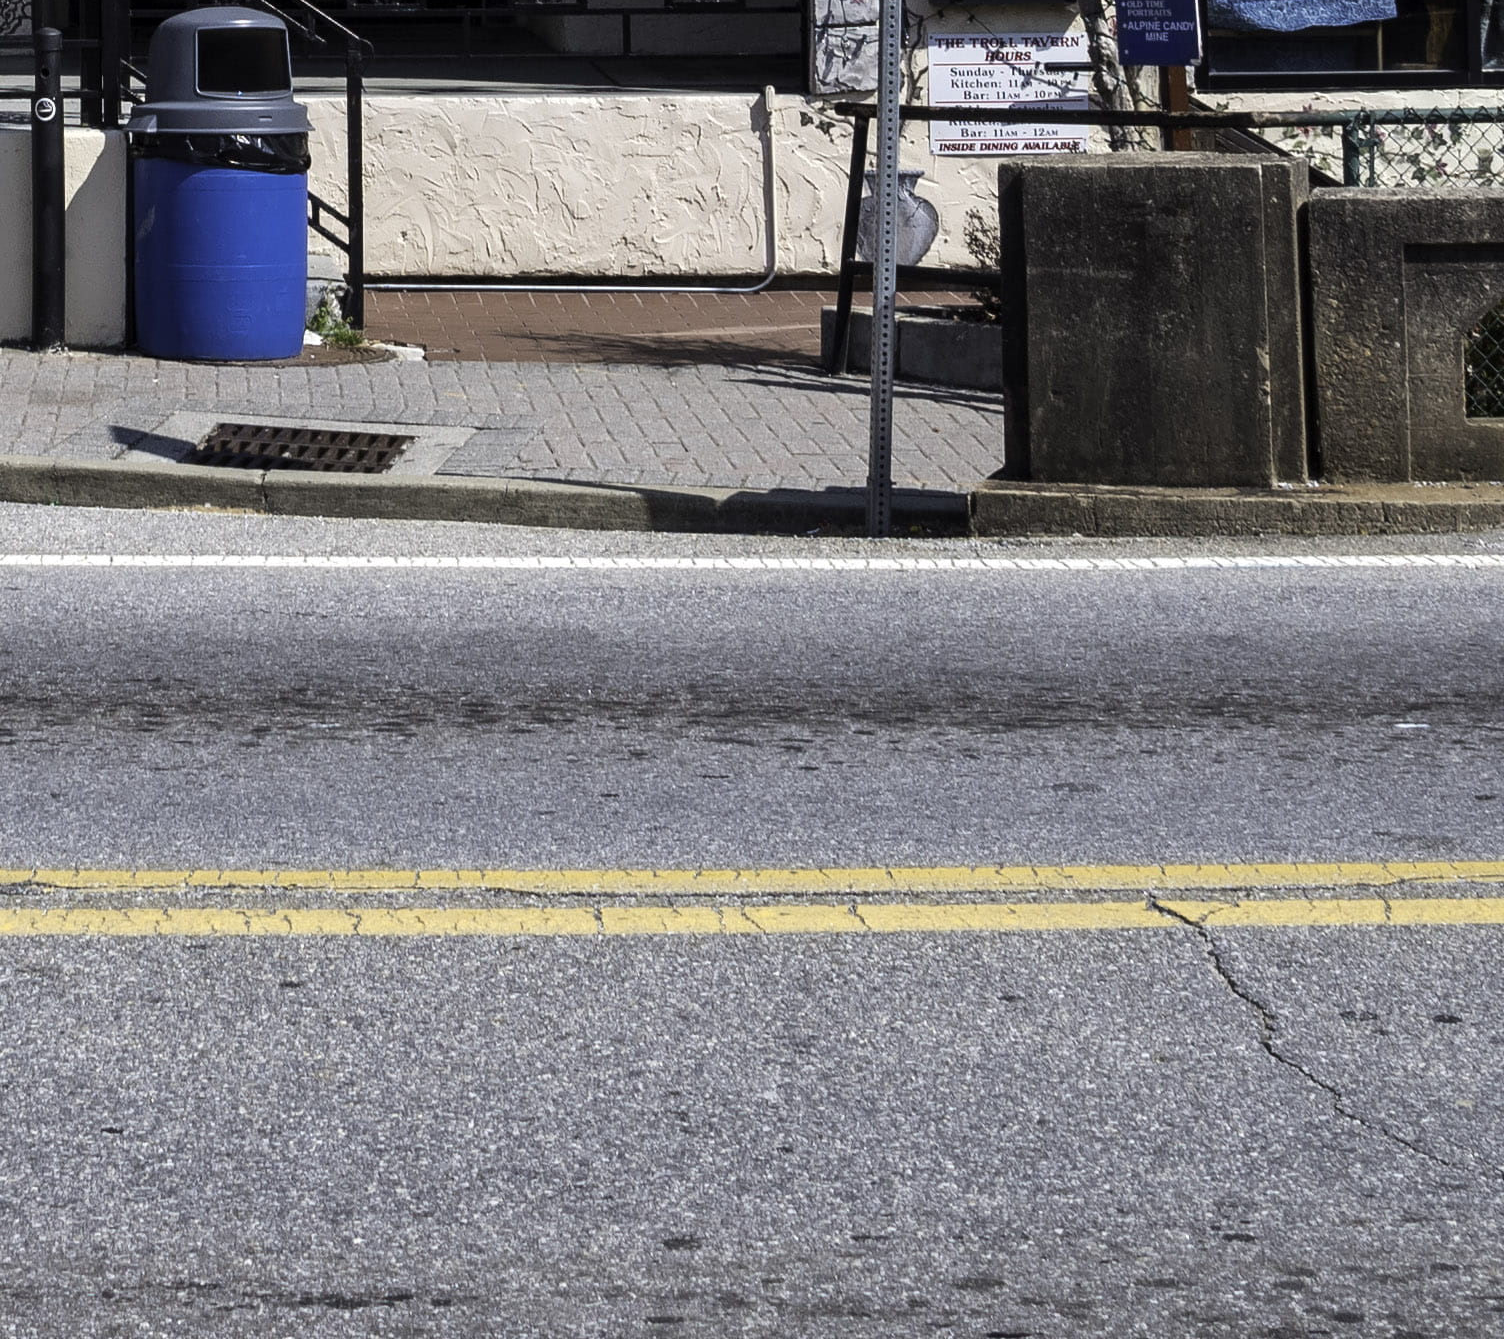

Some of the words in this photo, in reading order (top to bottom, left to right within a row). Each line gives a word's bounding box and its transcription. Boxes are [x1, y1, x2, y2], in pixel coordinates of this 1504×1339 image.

[1127, 0, 1144, 8] OLD
[1145, 0, 1165, 8] TIME
[1127, 9, 1172, 17] PORTRAITS
[1127, 21, 1161, 31] ALPINE
[1162, 21, 1195, 31] CANDY
[934, 37, 965, 48] THE
[970, 36, 1018, 48] TROLL
[1023, 36, 1080, 48] TAVERN
[1145, 32, 1169, 42] MINE
[985, 52, 1032, 62] HOURS
[950, 67, 995, 77] Sunday
[951, 79, 1002, 88] Kitchen:
[963, 91, 989, 100] Bar:
[960, 128, 988, 137] Bar:
[939, 142, 976, 152] INSIDE
[980, 142, 1018, 151] DINING
[1022, 141, 1080, 151] AVAILABLE
